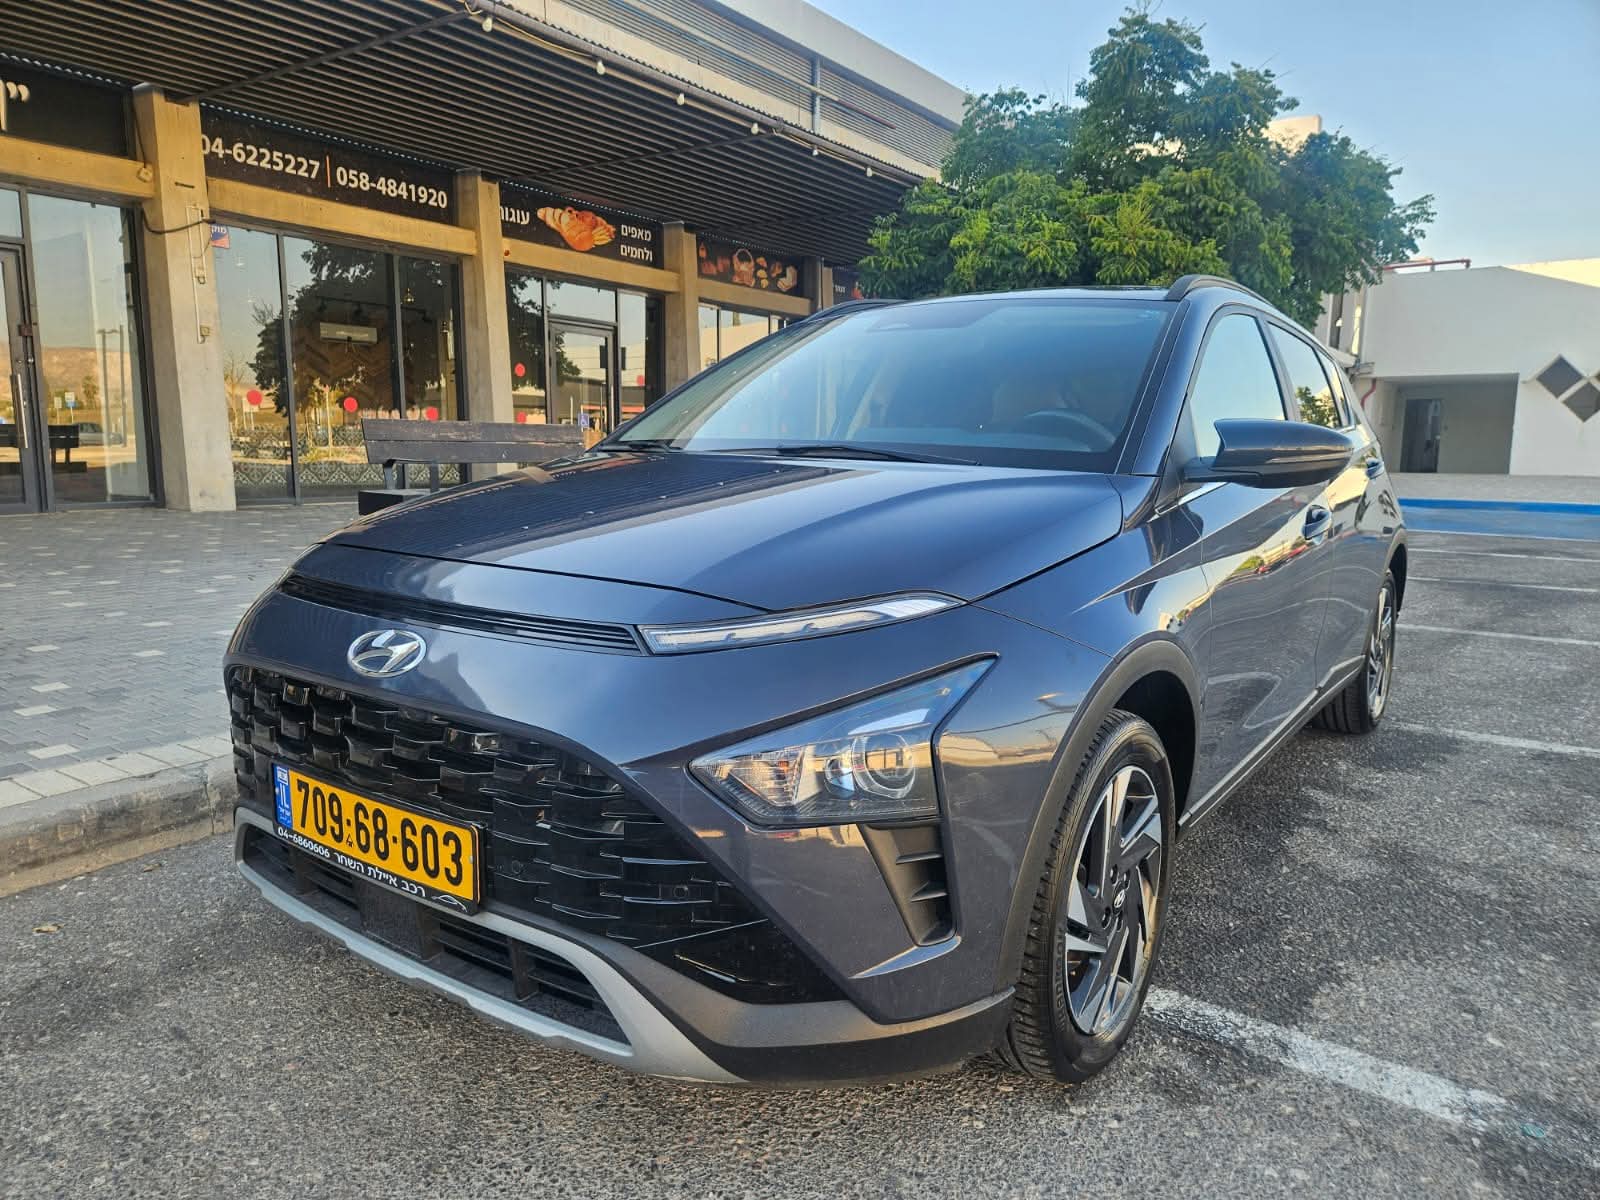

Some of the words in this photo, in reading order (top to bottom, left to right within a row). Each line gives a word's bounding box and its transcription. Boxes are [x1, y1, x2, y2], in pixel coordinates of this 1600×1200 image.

[201, 134, 320, 179] 04-6225227
[336, 166, 447, 208] 058-4841920
[621, 224, 652, 242] מאפים
[620, 244, 653, 262] ולחמים
[278, 826, 331, 858] 04-6860606
[334, 852, 364, 873] השחר
[367, 866, 398, 887] איילת
[400, 880, 426, 897] רכב
